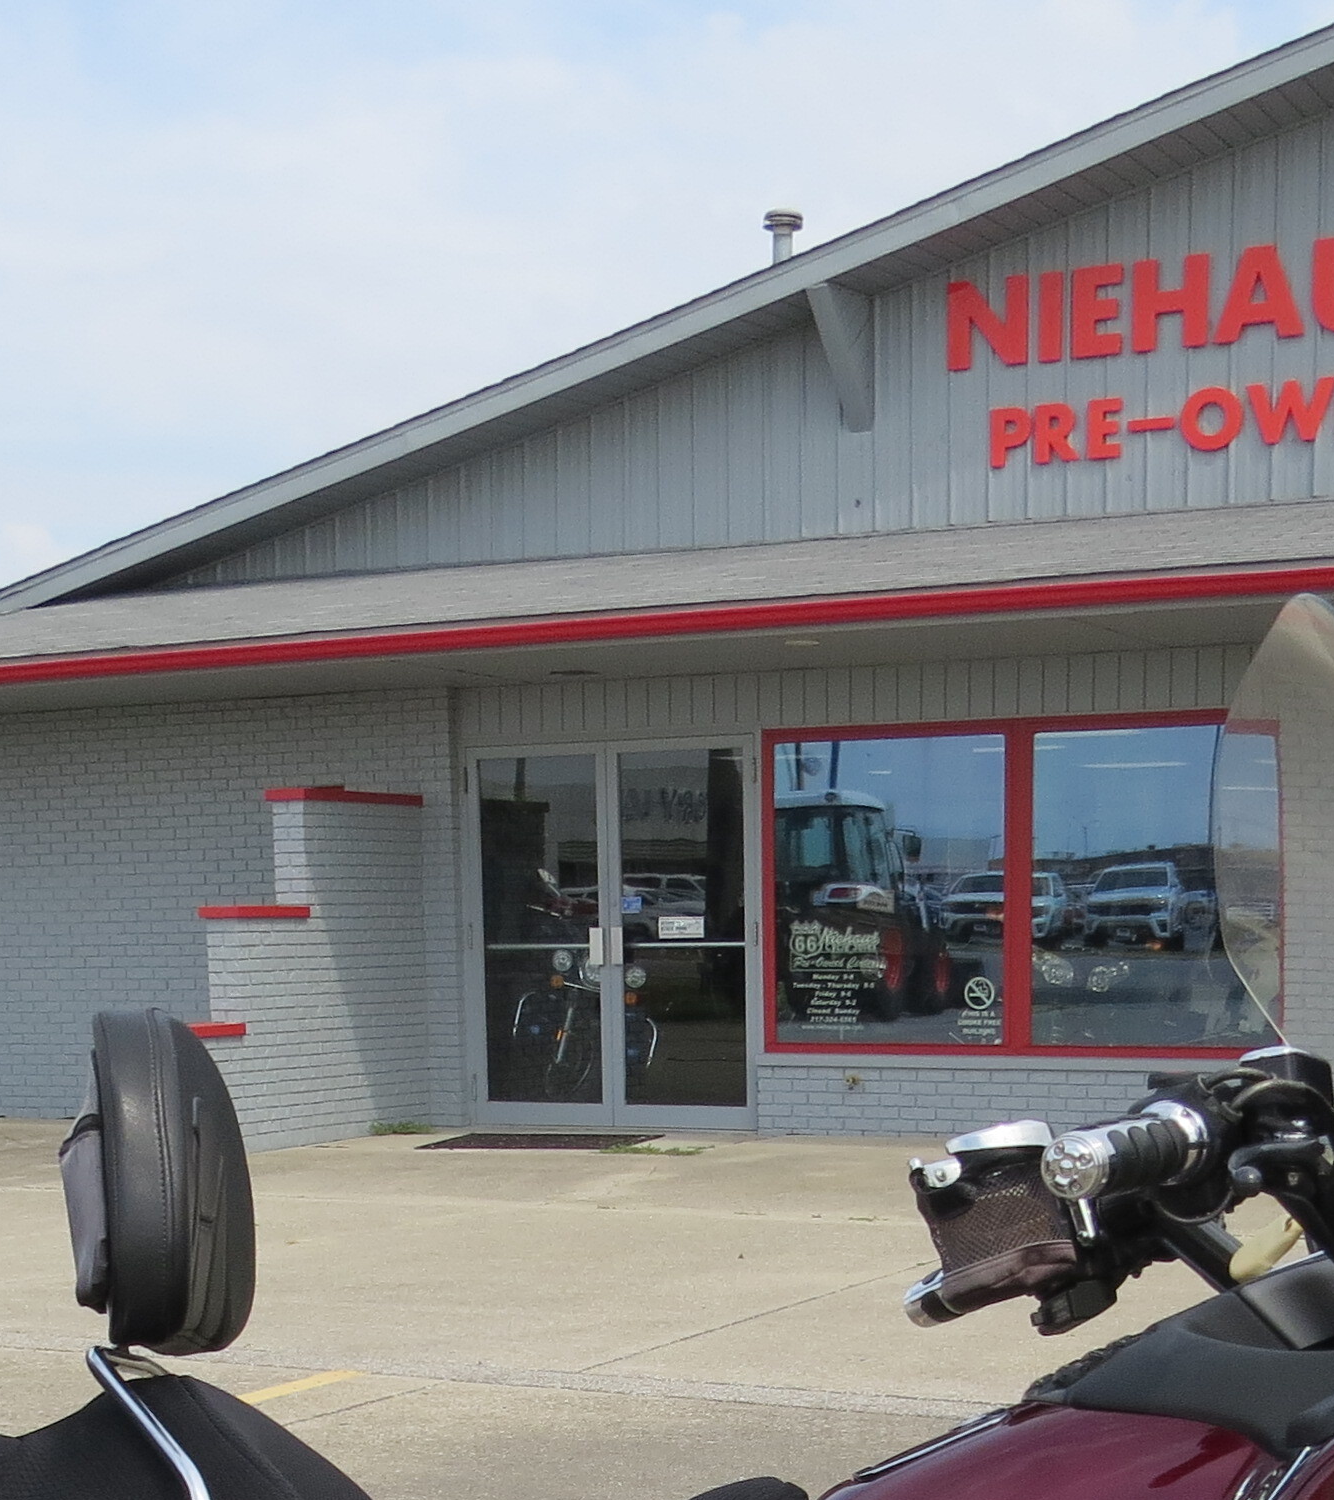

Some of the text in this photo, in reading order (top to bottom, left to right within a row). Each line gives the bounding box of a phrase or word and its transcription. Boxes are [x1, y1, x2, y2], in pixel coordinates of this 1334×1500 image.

[794, 935, 818, 952] 66
[812, 973, 840, 981] Monday
[827, 982, 860, 990] Thursday
